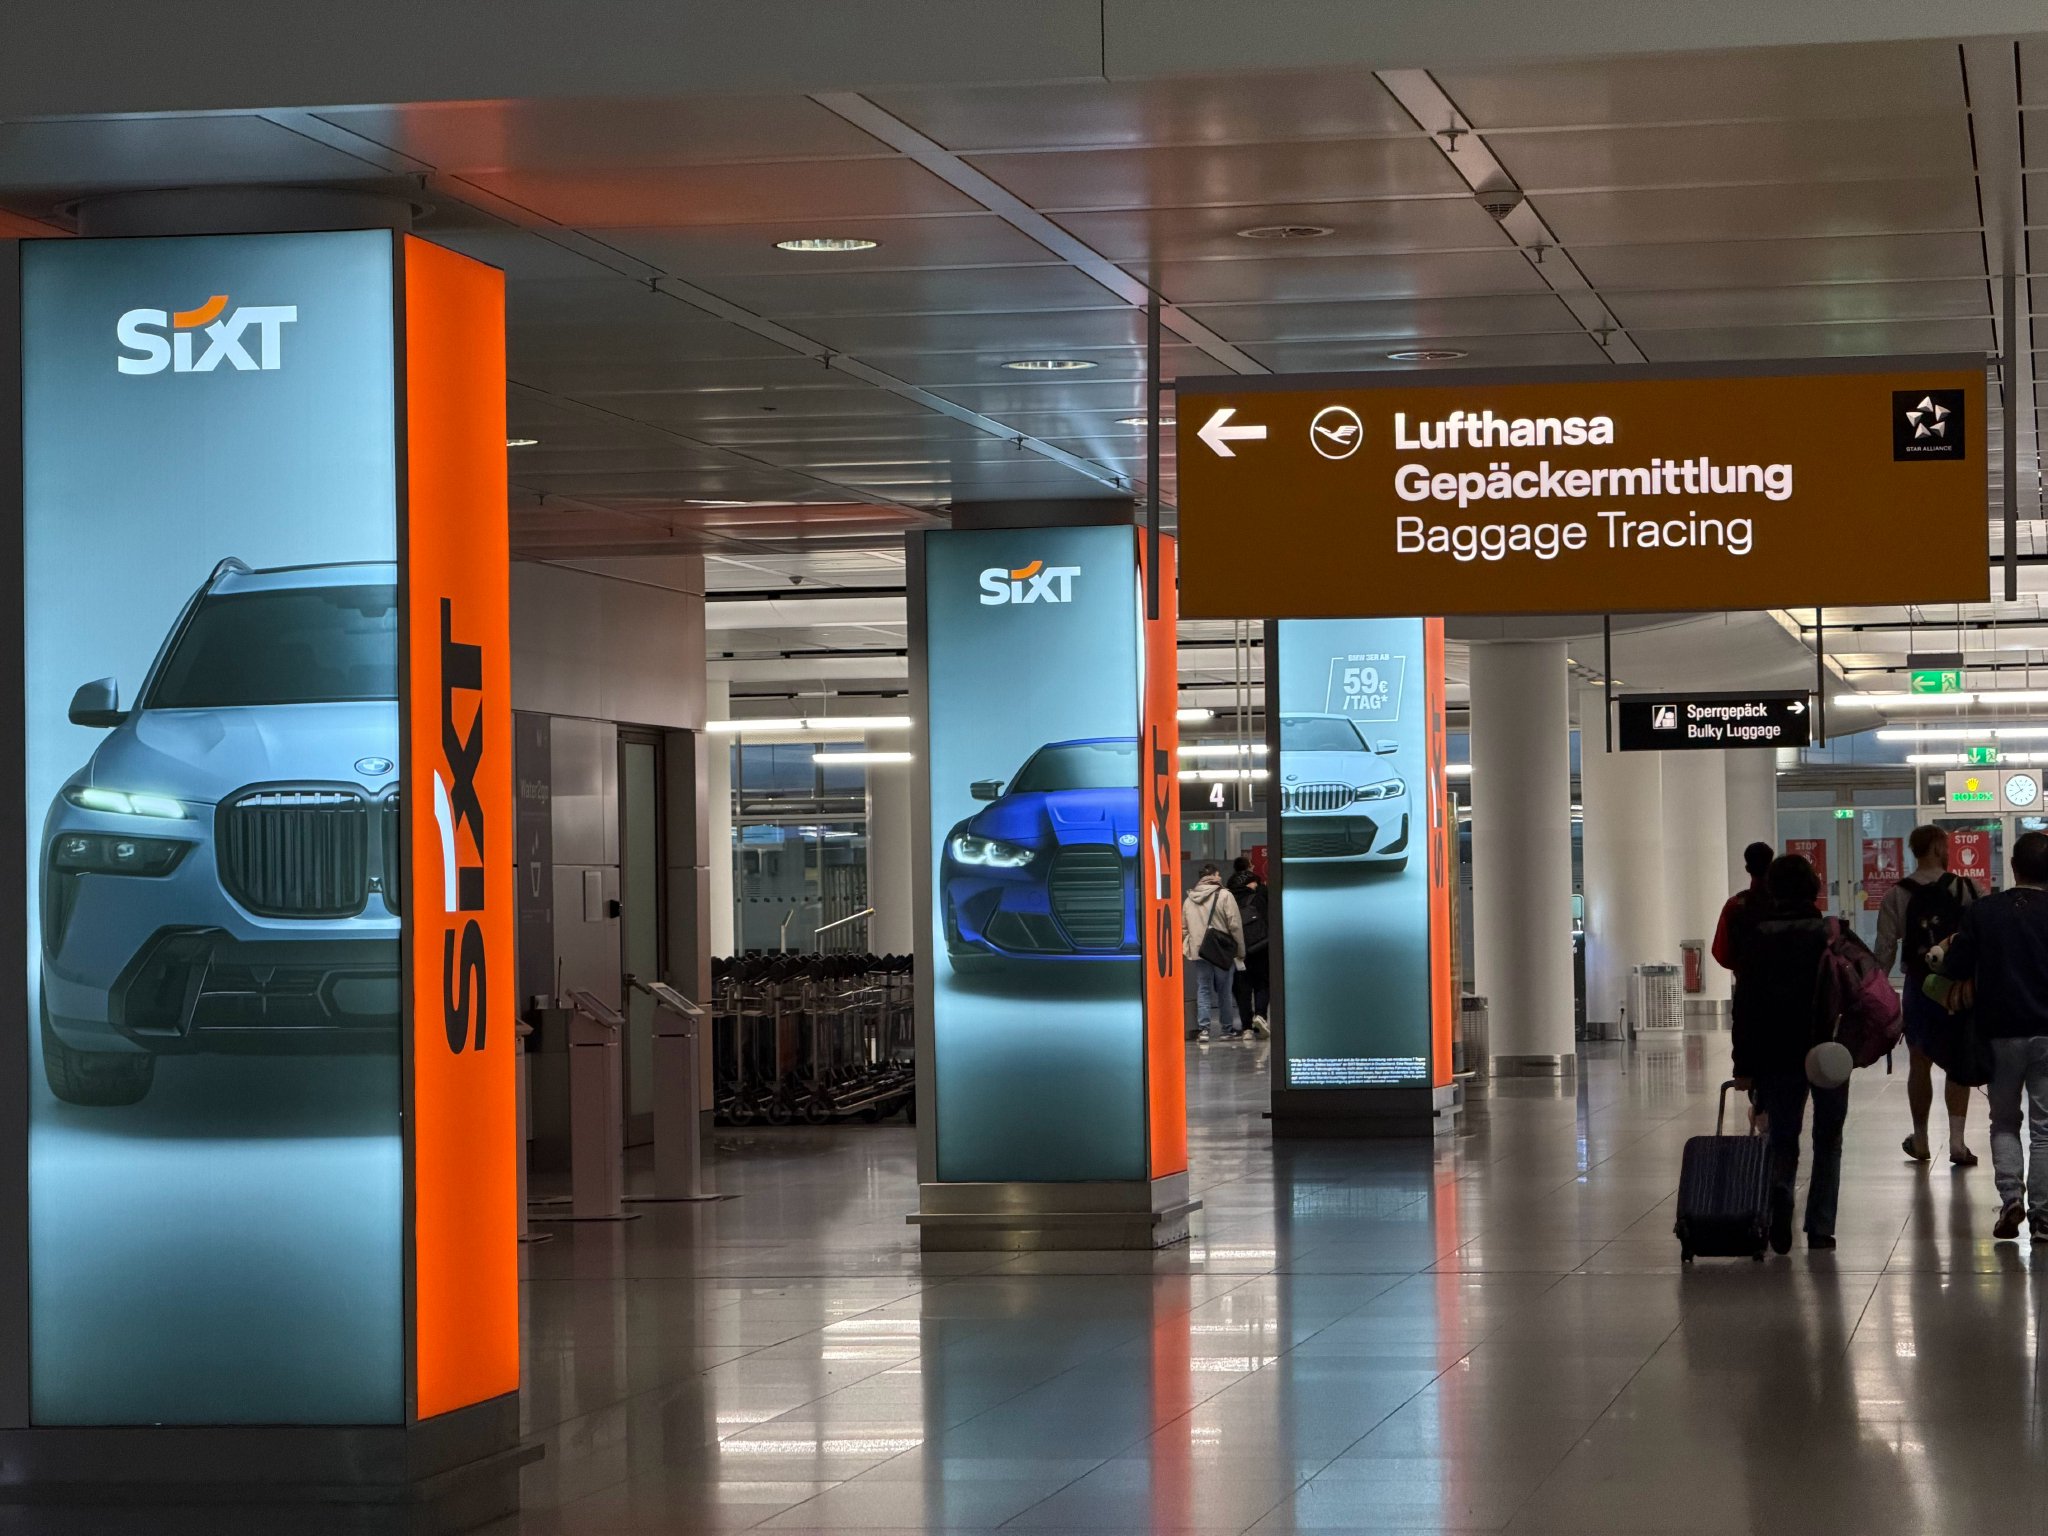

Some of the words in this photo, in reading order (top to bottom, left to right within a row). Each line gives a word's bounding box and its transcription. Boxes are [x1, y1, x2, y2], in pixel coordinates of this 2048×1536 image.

[1394, 410, 1614, 450] Lufthansa
[1394, 457, 1793, 508] Gepäckermittlung
[1396, 514, 1587, 561] Baggage
[1597, 510, 1753, 555] Tracing
[1687, 703, 1767, 721] Sperrgepäck
[1688, 724, 1723, 740] Bulky
[1727, 723, 1781, 739] Luggage
[1210, 782, 1224, 808] 4
[1952, 792, 1994, 801] ROLEX
[1795, 842, 1817, 850] STOP
[1954, 835, 1979, 844] STOP
[1868, 872, 1900, 880] ALARM
